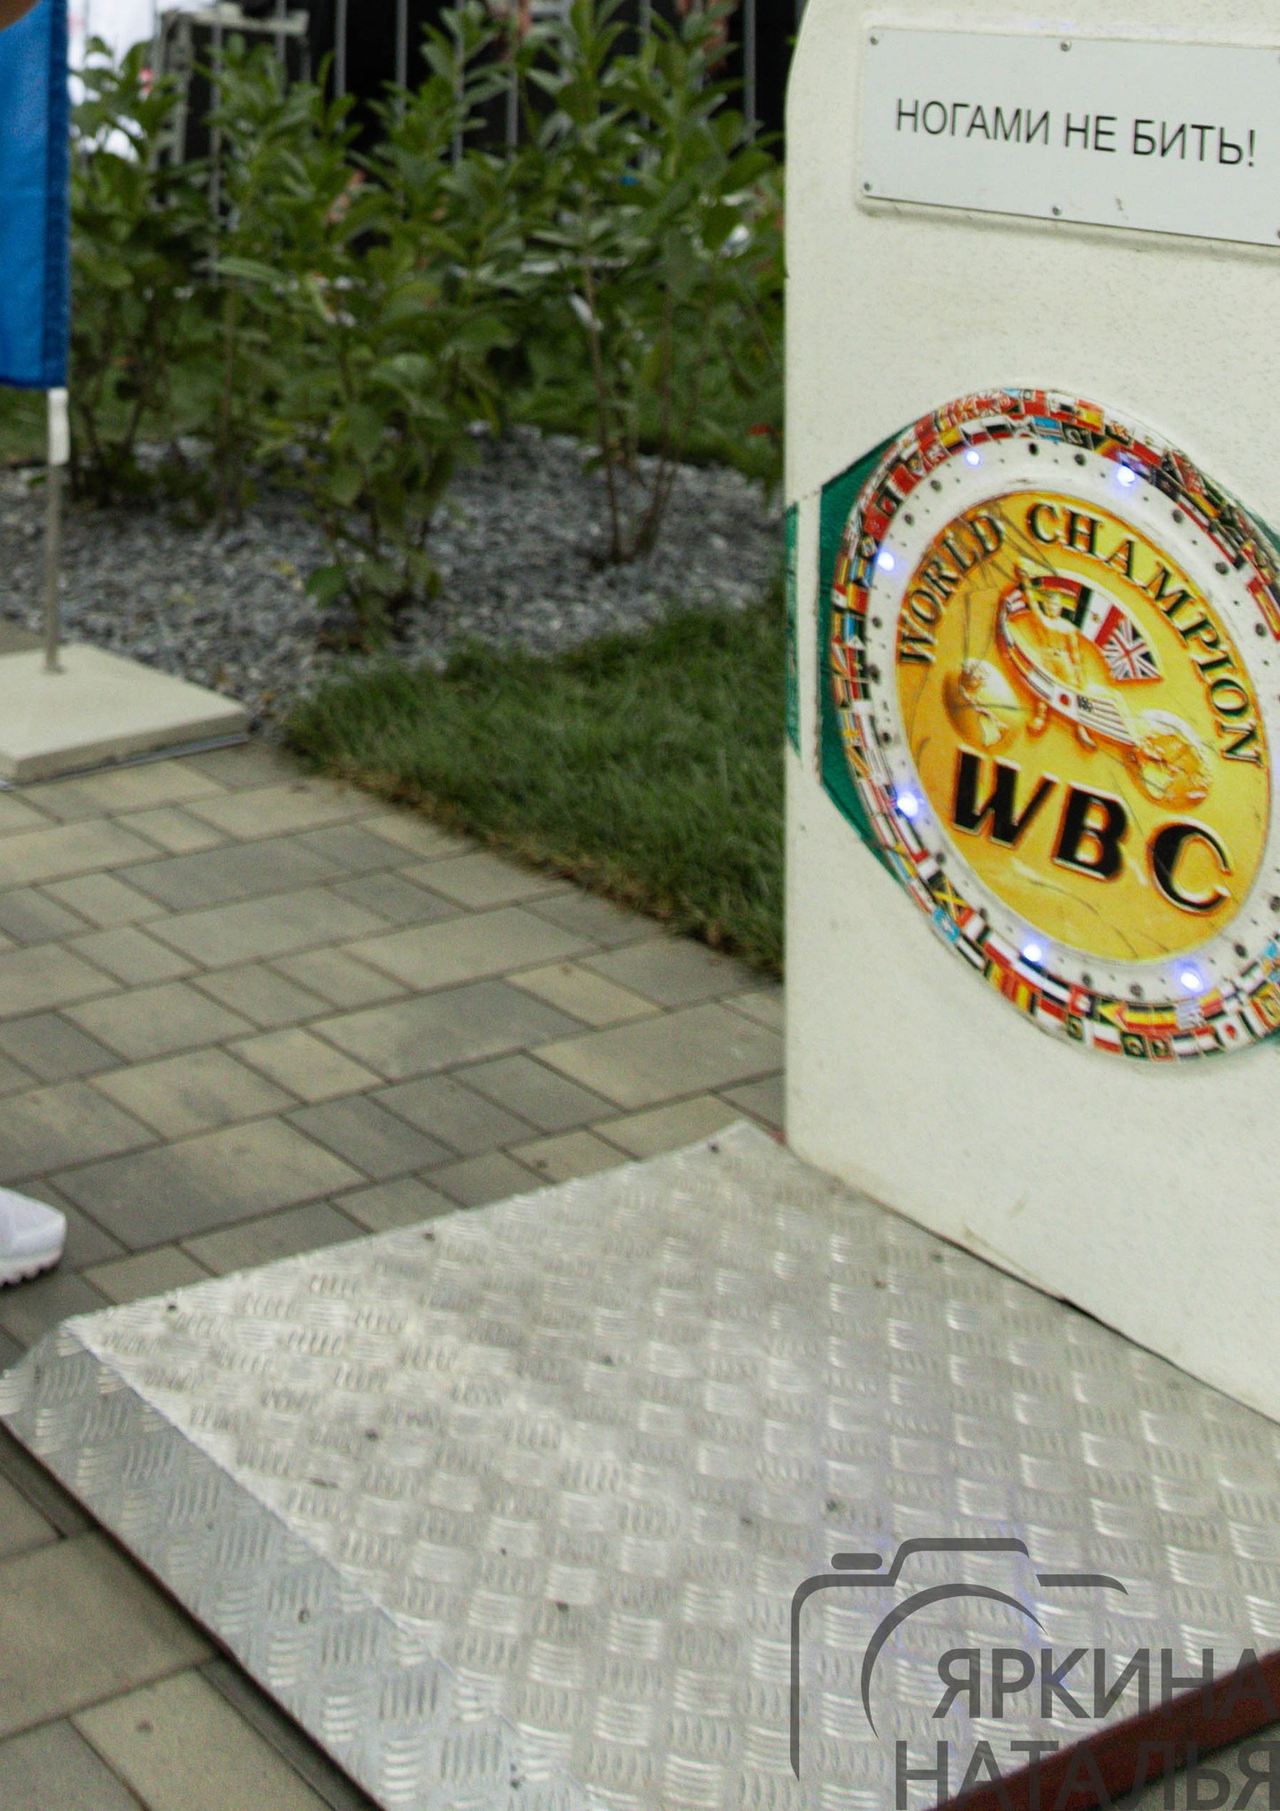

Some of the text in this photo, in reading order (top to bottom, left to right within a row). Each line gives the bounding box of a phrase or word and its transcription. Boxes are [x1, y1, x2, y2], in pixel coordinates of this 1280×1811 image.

[896, 98, 1257, 168] НОГАМИ НЕ БИТЬ!
[899, 501, 1265, 769] WORLD CHAMPION
[950, 745, 1235, 917] WBC
